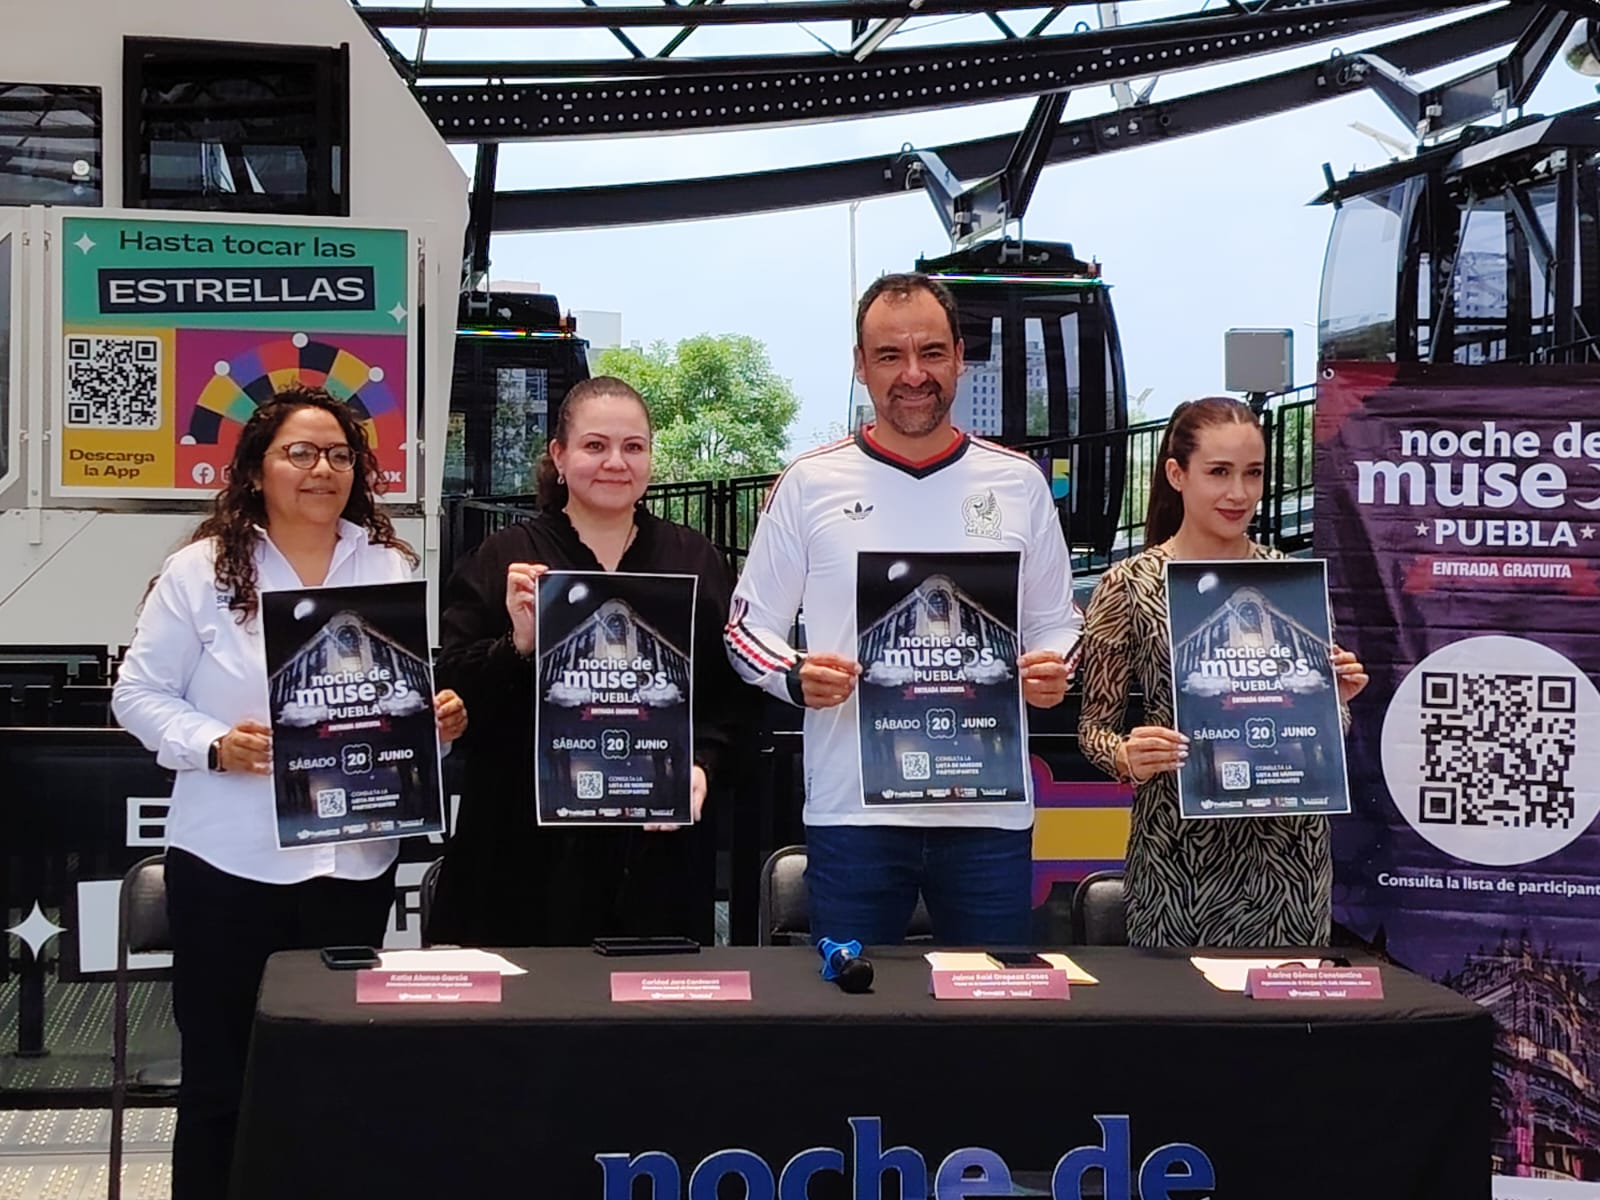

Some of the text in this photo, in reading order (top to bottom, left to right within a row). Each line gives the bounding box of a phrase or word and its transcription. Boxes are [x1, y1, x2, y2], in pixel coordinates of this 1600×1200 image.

[119, 230, 356, 259] Hasta tocar las
[108, 276, 367, 305] ESTRELLAS
[1400, 421, 1600, 459] noche de
[69, 448, 155, 465] Descarga
[83, 464, 141, 480] la App
[1434, 519, 1578, 547] PUEBLA
[1432, 561, 1572, 578] ENTRADA GRATUITA
[900, 632, 977, 648] noche de
[884, 647, 994, 667] museos
[1216, 644, 1291, 659] noche de
[579, 656, 651, 670] noche de
[1200, 658, 1310, 678] museos
[311, 666, 390, 687] noche de
[563, 670, 668, 689] museos
[914, 670, 966, 682] PUEBLA
[295, 679, 408, 707] museos
[1232, 680, 1284, 692] PUEBLA
[592, 692, 641, 703] PUEBLA
[328, 704, 381, 719] PUEBLA
[874, 718, 997, 731] SÁBADO 20 JUNIO
[1194, 726, 1316, 741] SÁBADO 20 JUNIO
[553, 737, 668, 751] SÁBADO 20 JUNIO
[289, 749, 414, 771] SÁBADO 20 JUNIO
[1378, 873, 1443, 889] Consulta
[1446, 876, 1459, 889] la
[1463, 877, 1493, 890] lista
[1497, 878, 1515, 891] de
[595, 1114, 1215, 1200] noche de
